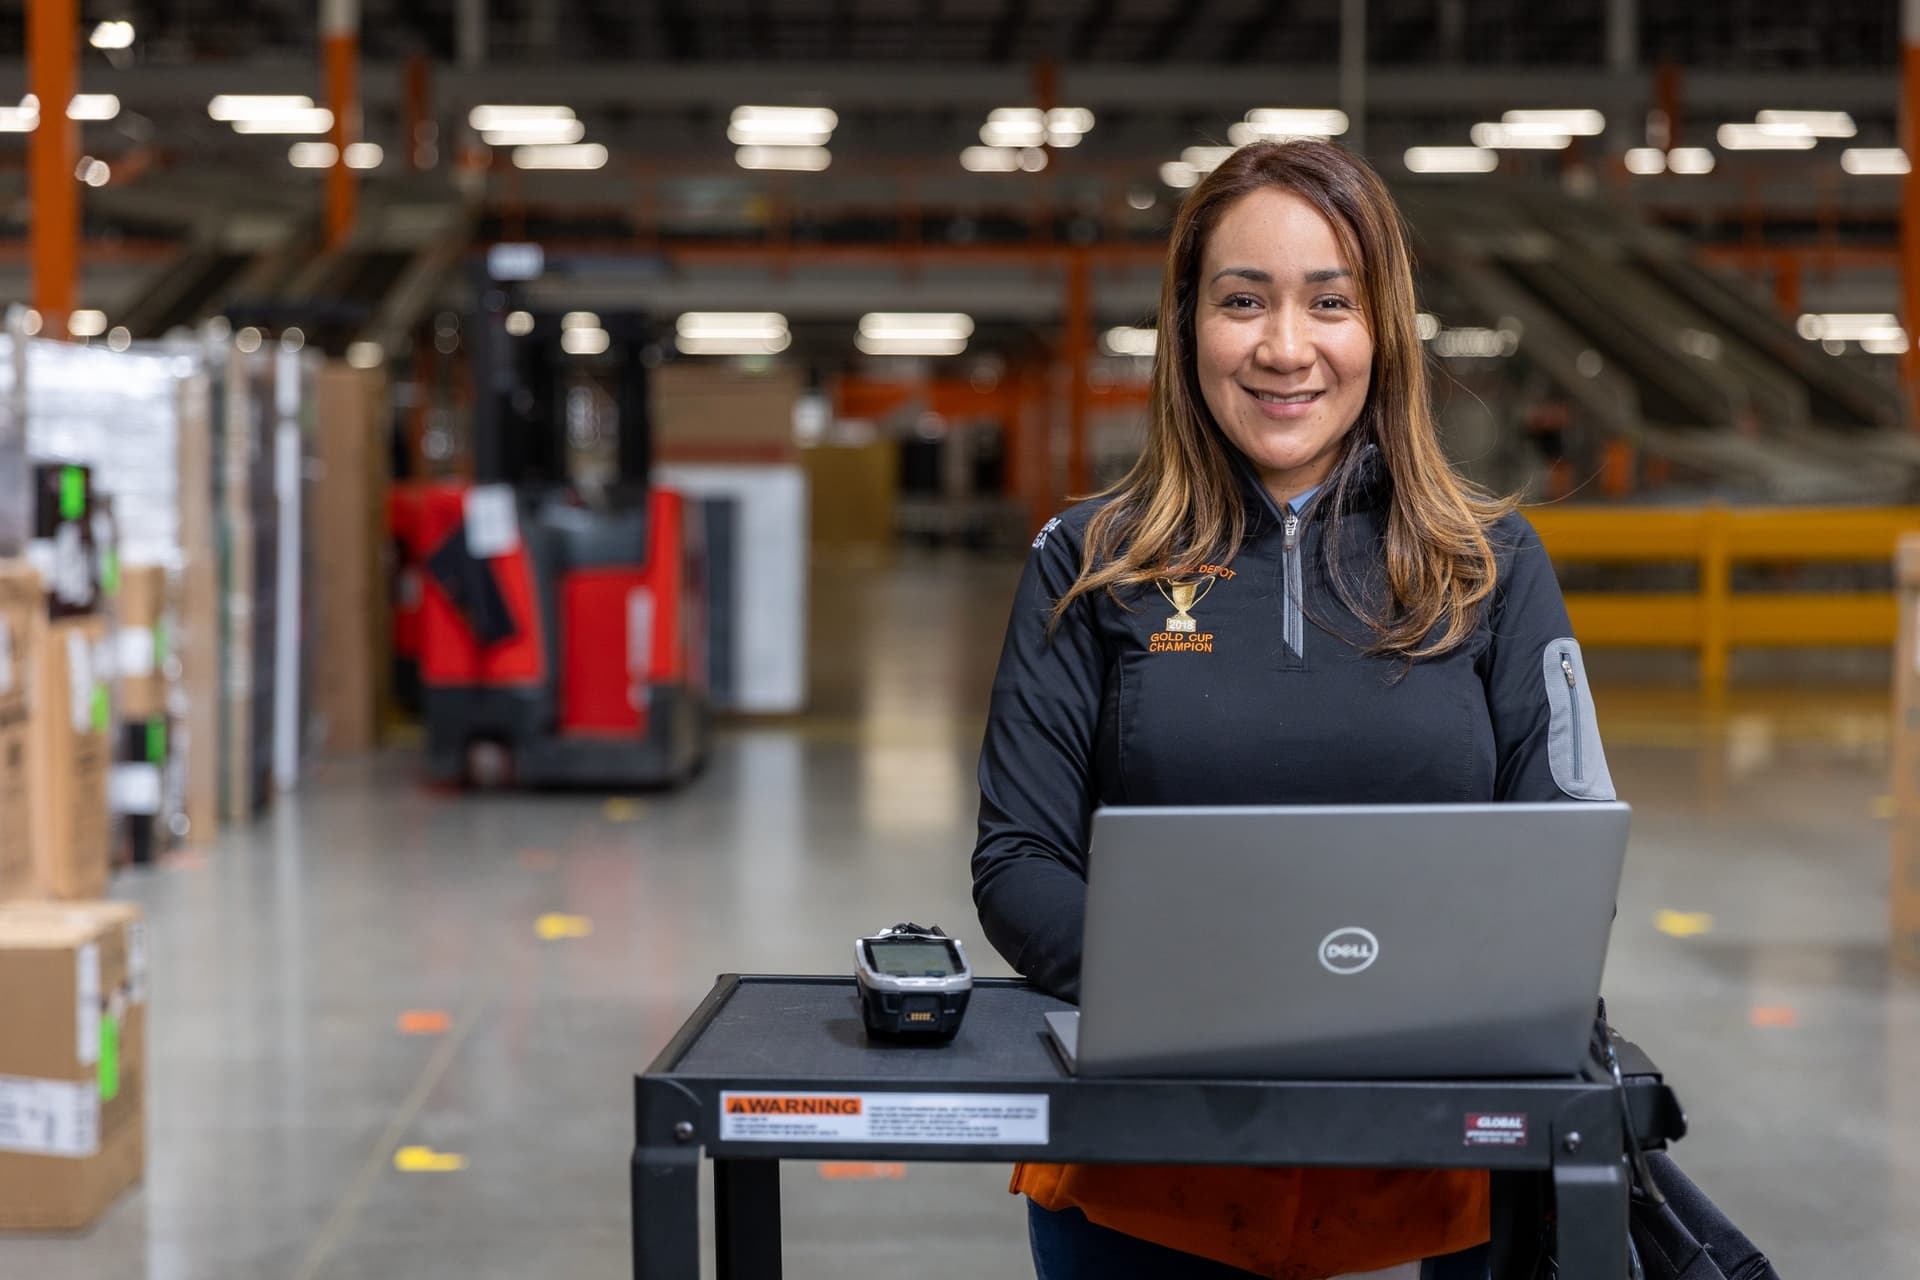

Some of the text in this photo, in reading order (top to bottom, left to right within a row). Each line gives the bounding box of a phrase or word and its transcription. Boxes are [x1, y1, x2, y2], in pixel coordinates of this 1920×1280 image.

[1199, 564, 1237, 580] DEPOT
[1150, 632, 1214, 642] GOLD CUP
[1149, 642, 1213, 652] CHAMPION
[1326, 943, 1371, 959] DELL
[749, 1098, 858, 1114] WARNING
[1476, 1116, 1523, 1129] GLOBAL
